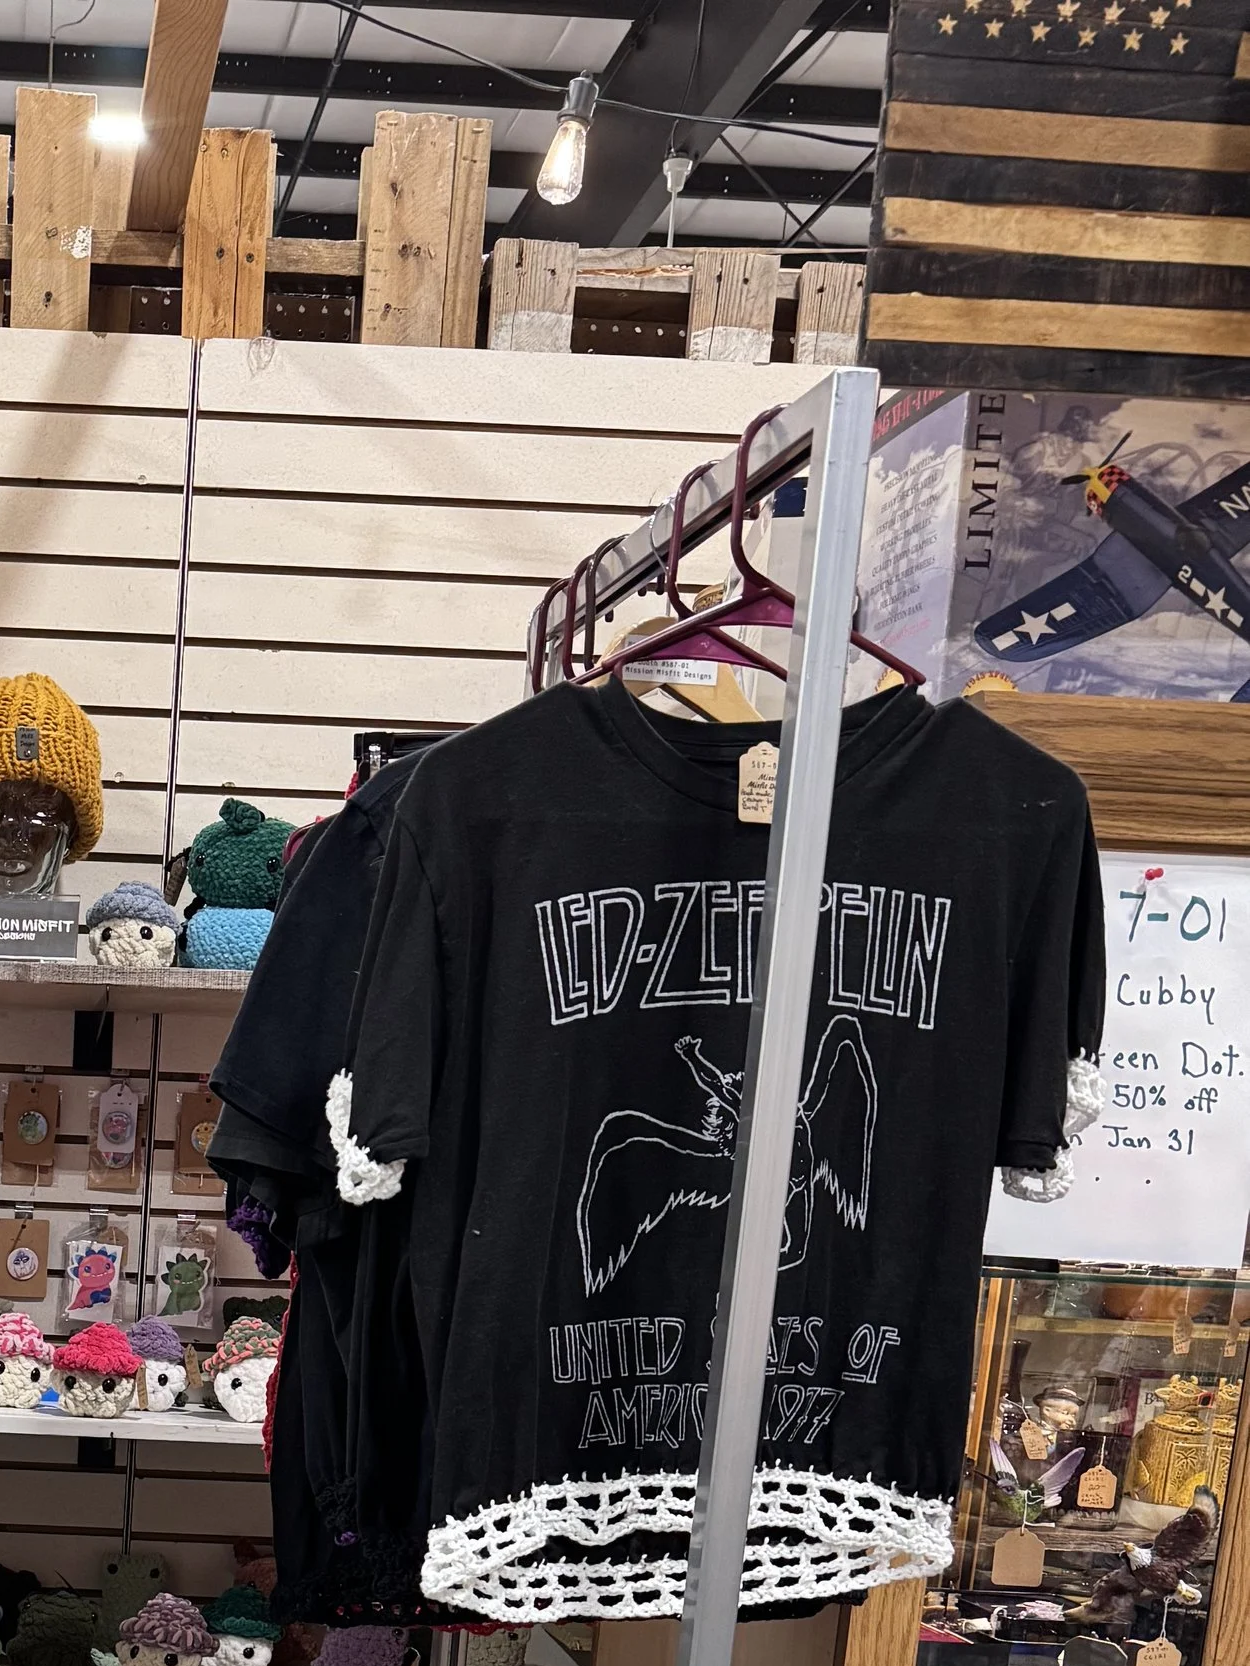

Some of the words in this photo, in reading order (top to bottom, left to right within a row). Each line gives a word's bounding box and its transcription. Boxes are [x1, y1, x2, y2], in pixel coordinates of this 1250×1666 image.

[625, 666, 653, 675] Mission
[684, 671, 712, 680] Designs
[22, 919, 75, 933] MISFIT
[1117, 973, 1215, 1025] Cubby
[1111, 1083, 1167, 1110] 50%
[1184, 1087, 1219, 1113] off
[1102, 1124, 1152, 1149] Jan
[1168, 1128, 1195, 1155] 31
[550, 1317, 685, 1384] UNITED
[842, 1323, 901, 1384] OF
[578, 1383, 713, 1449] AMERIC
